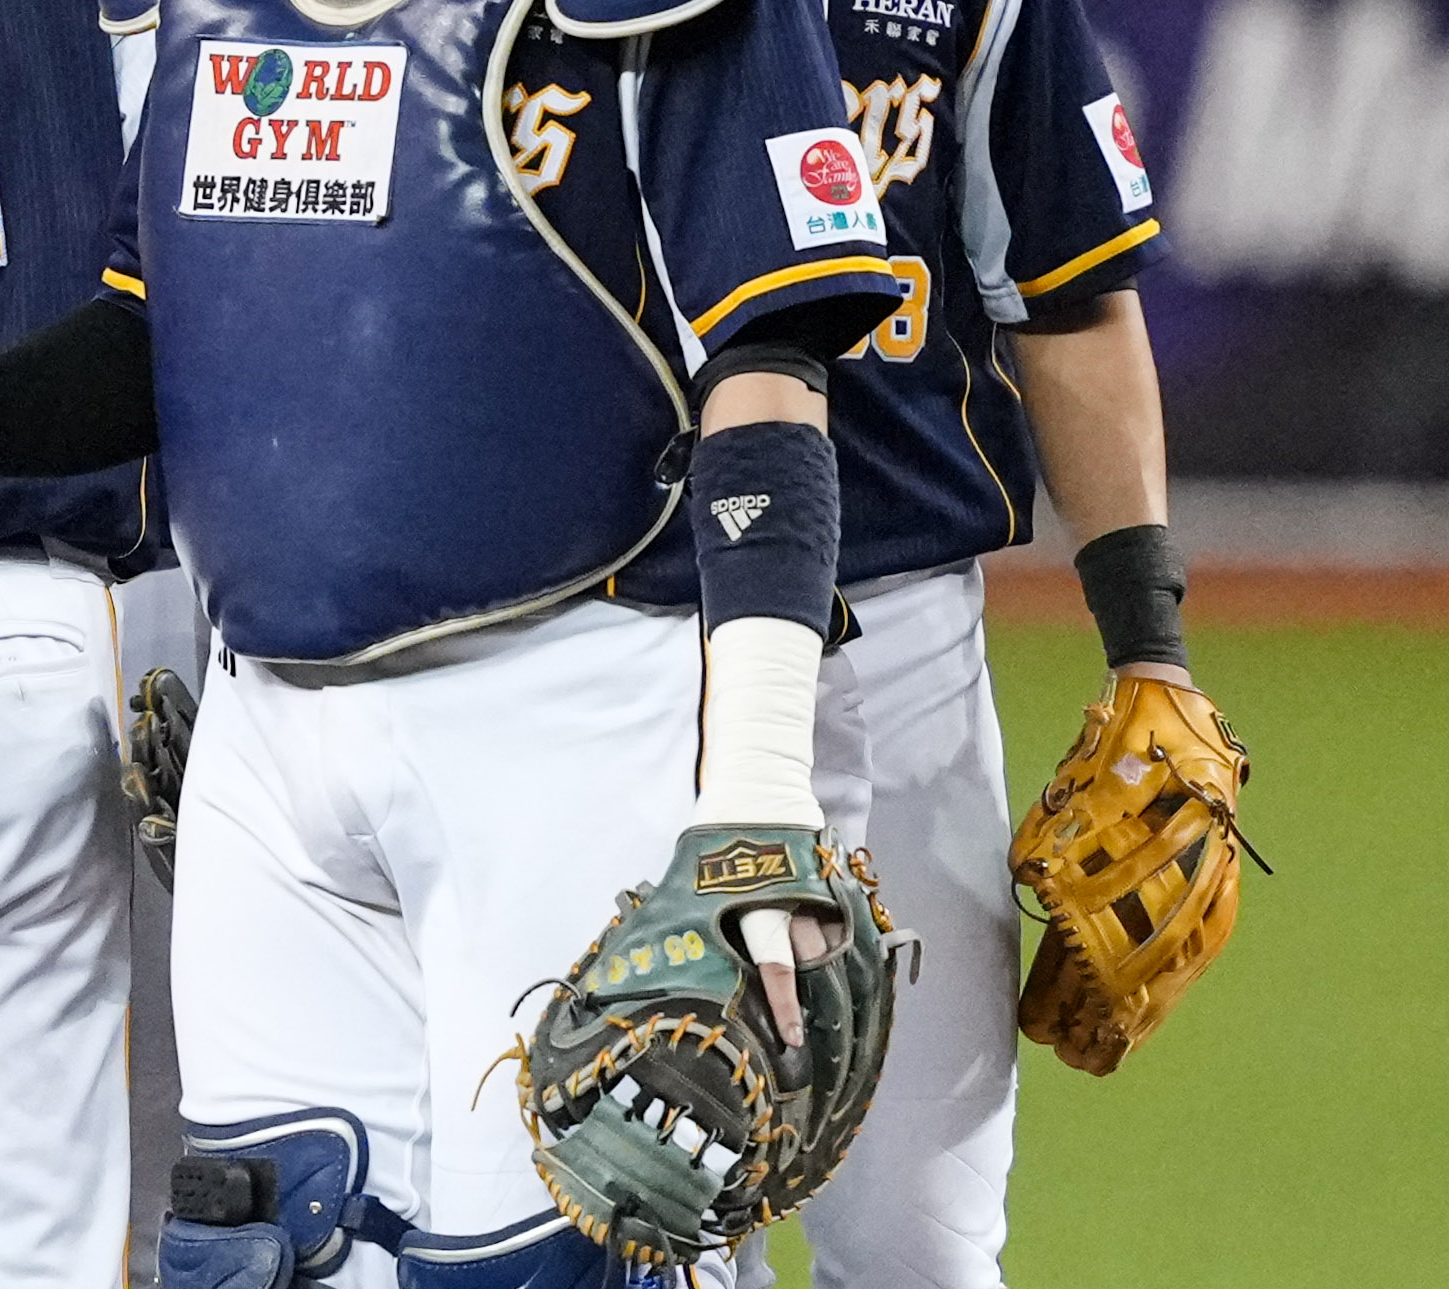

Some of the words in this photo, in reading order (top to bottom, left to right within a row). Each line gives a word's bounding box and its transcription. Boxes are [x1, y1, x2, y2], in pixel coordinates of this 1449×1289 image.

[209, 48, 392, 117] WORLD
[192, 175, 375, 216] 世界健身俱樂部
[710, 494, 771, 516] adidas
[699, 853, 786, 887] ZETT
